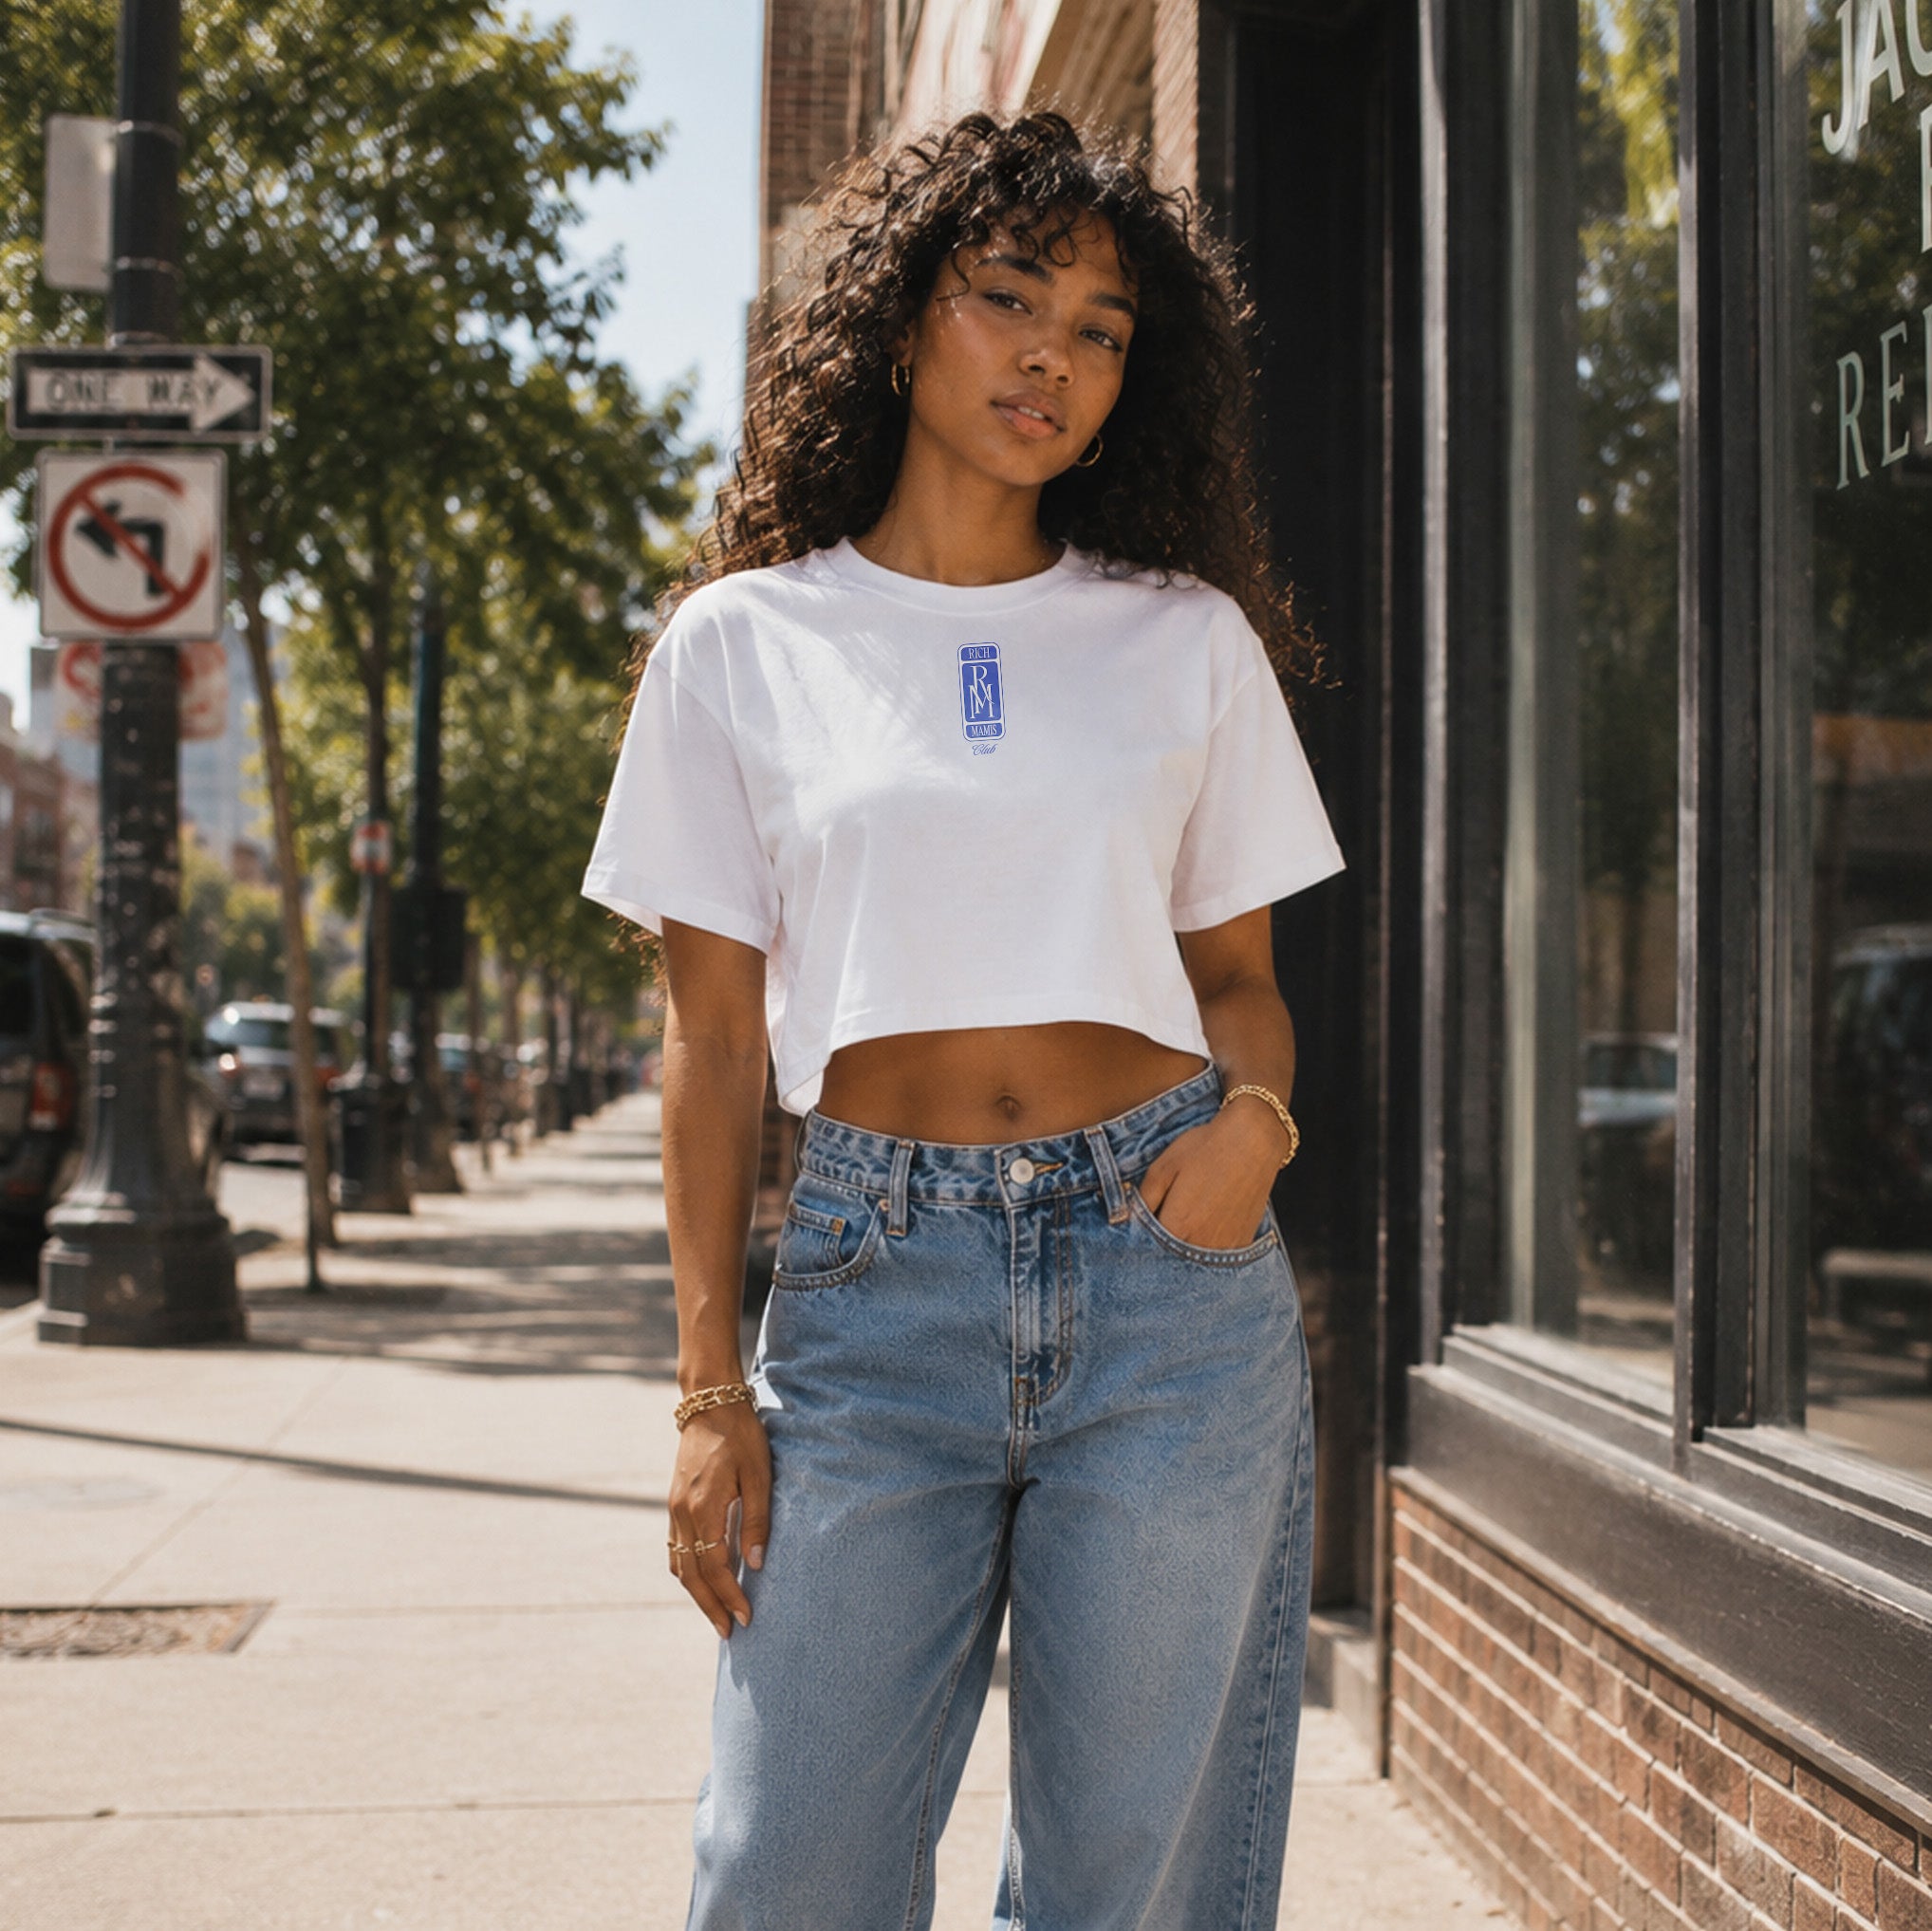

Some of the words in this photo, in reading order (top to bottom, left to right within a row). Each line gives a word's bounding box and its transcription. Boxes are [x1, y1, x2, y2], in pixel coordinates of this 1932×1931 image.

[46, 370, 124, 410] ONE
[145, 373, 224, 409] WAY
[968, 647, 991, 659] RICH
[971, 724, 997, 736] MAMIS
[972, 743, 997, 756] Club
